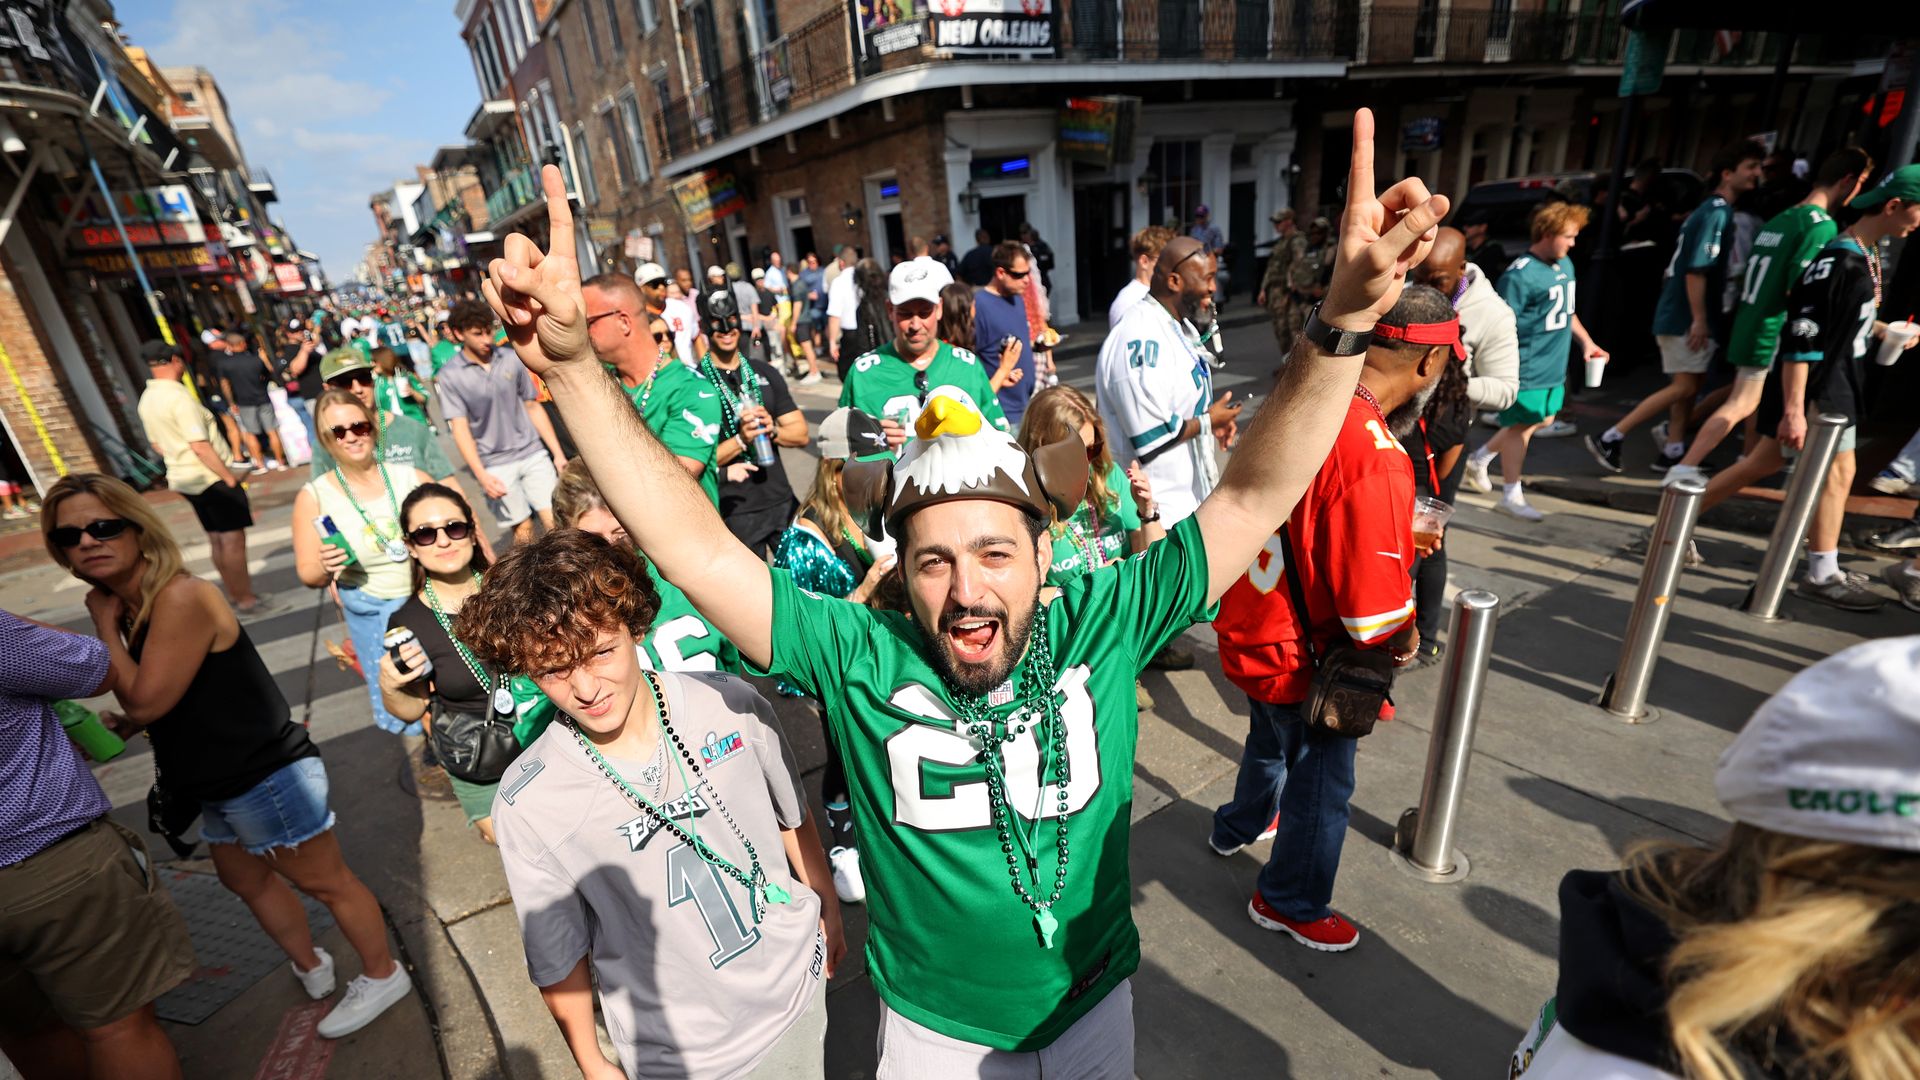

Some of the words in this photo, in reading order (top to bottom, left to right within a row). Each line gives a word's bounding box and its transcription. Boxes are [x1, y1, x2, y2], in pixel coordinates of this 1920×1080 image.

[938, 19, 979, 46] NEW
[979, 18, 1051, 46] ORLEANS
[1742, 254, 1772, 304] 11
[1127, 339, 1159, 369] 20
[991, 691, 1014, 705] NFL
[884, 661, 1103, 833] 20
[500, 756, 545, 806] 1
[645, 771, 662, 784] NFL
[616, 782, 710, 852] ELES
[666, 835, 762, 970] 1
